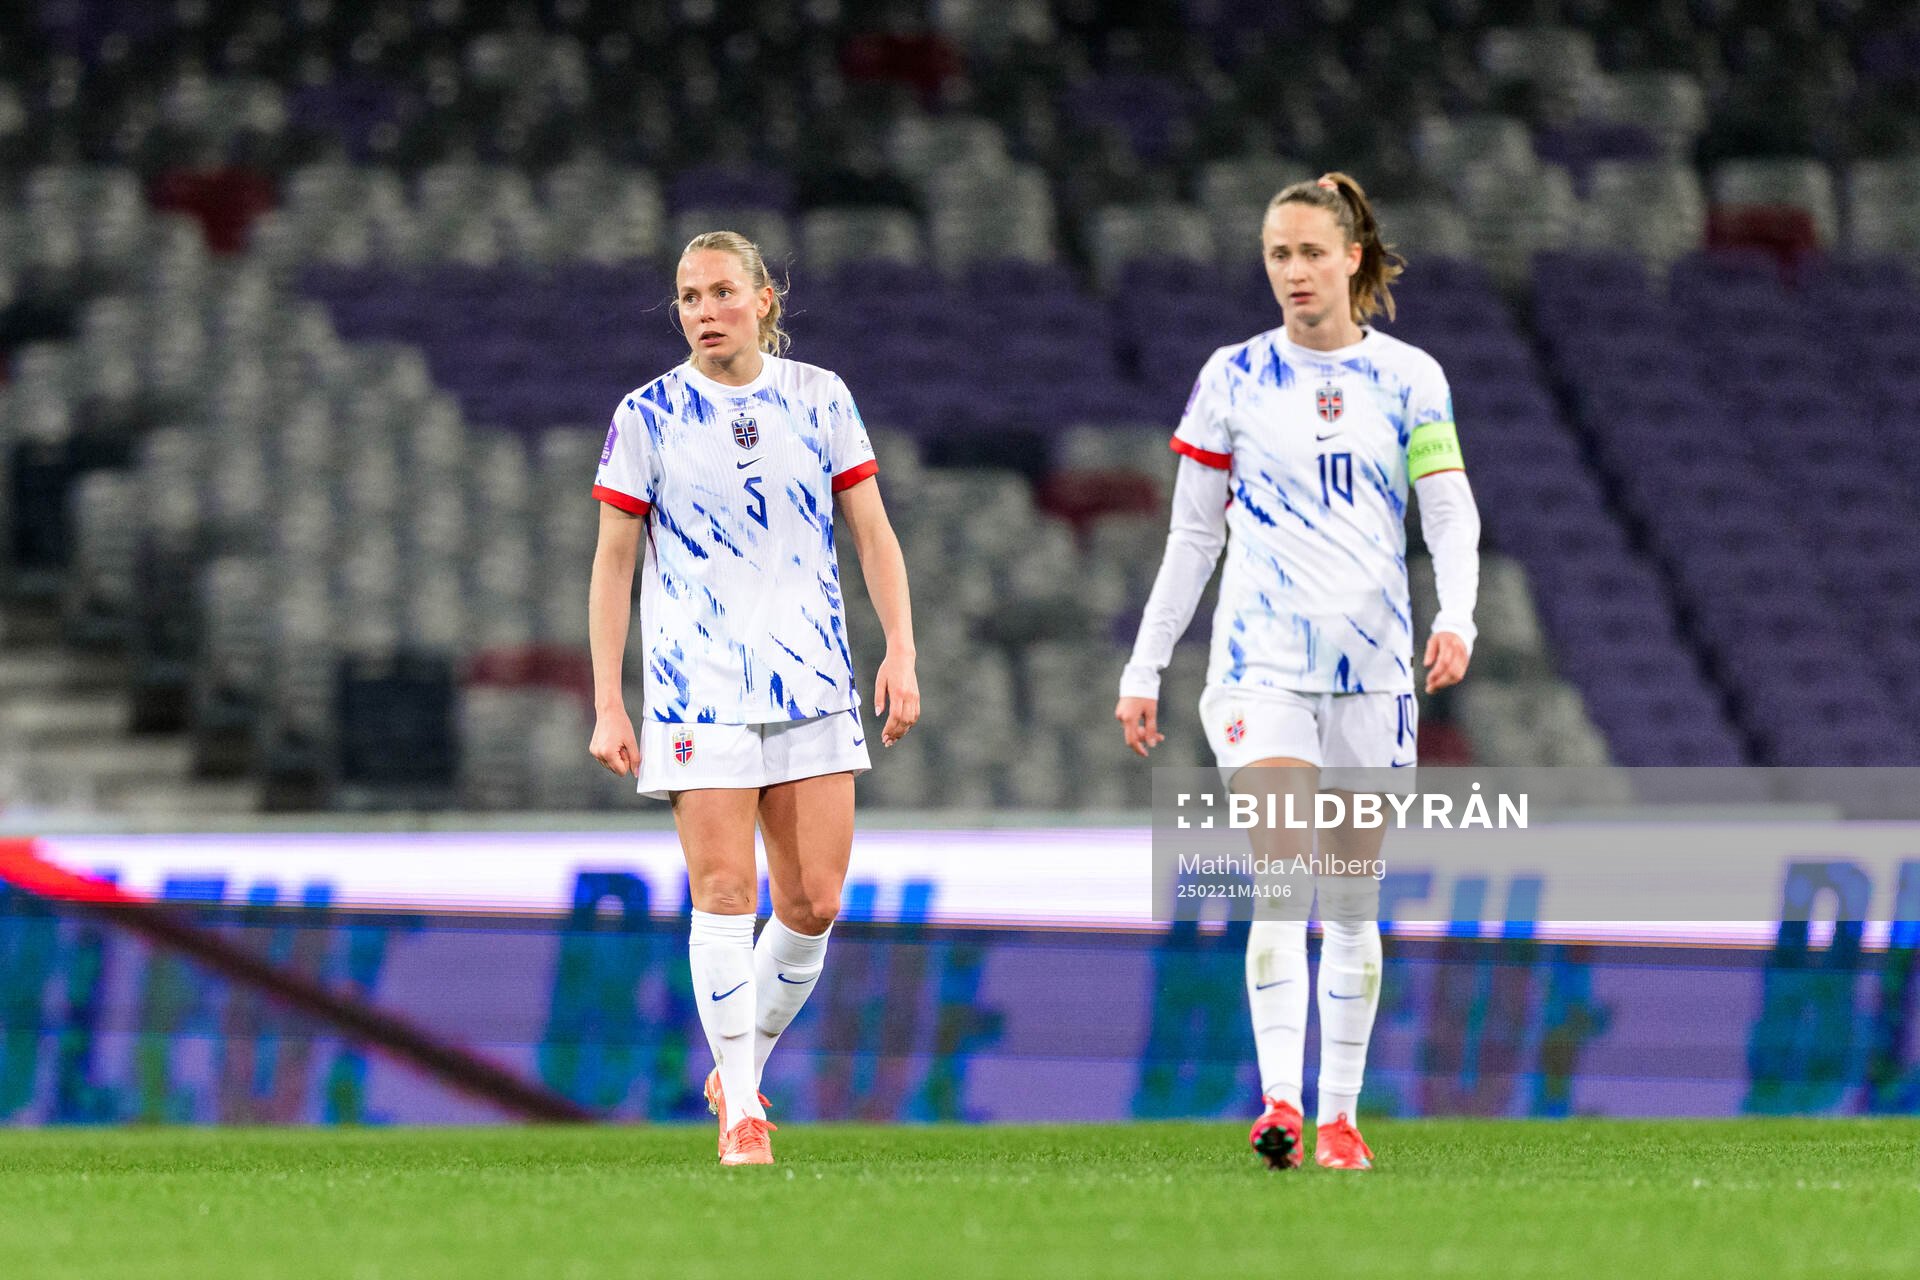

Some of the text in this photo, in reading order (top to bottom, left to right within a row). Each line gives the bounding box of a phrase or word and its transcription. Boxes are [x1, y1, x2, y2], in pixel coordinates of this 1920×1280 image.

[744, 476, 768, 530] 5
[1316, 453, 1354, 507] 10
[1396, 693, 1415, 747] 10
